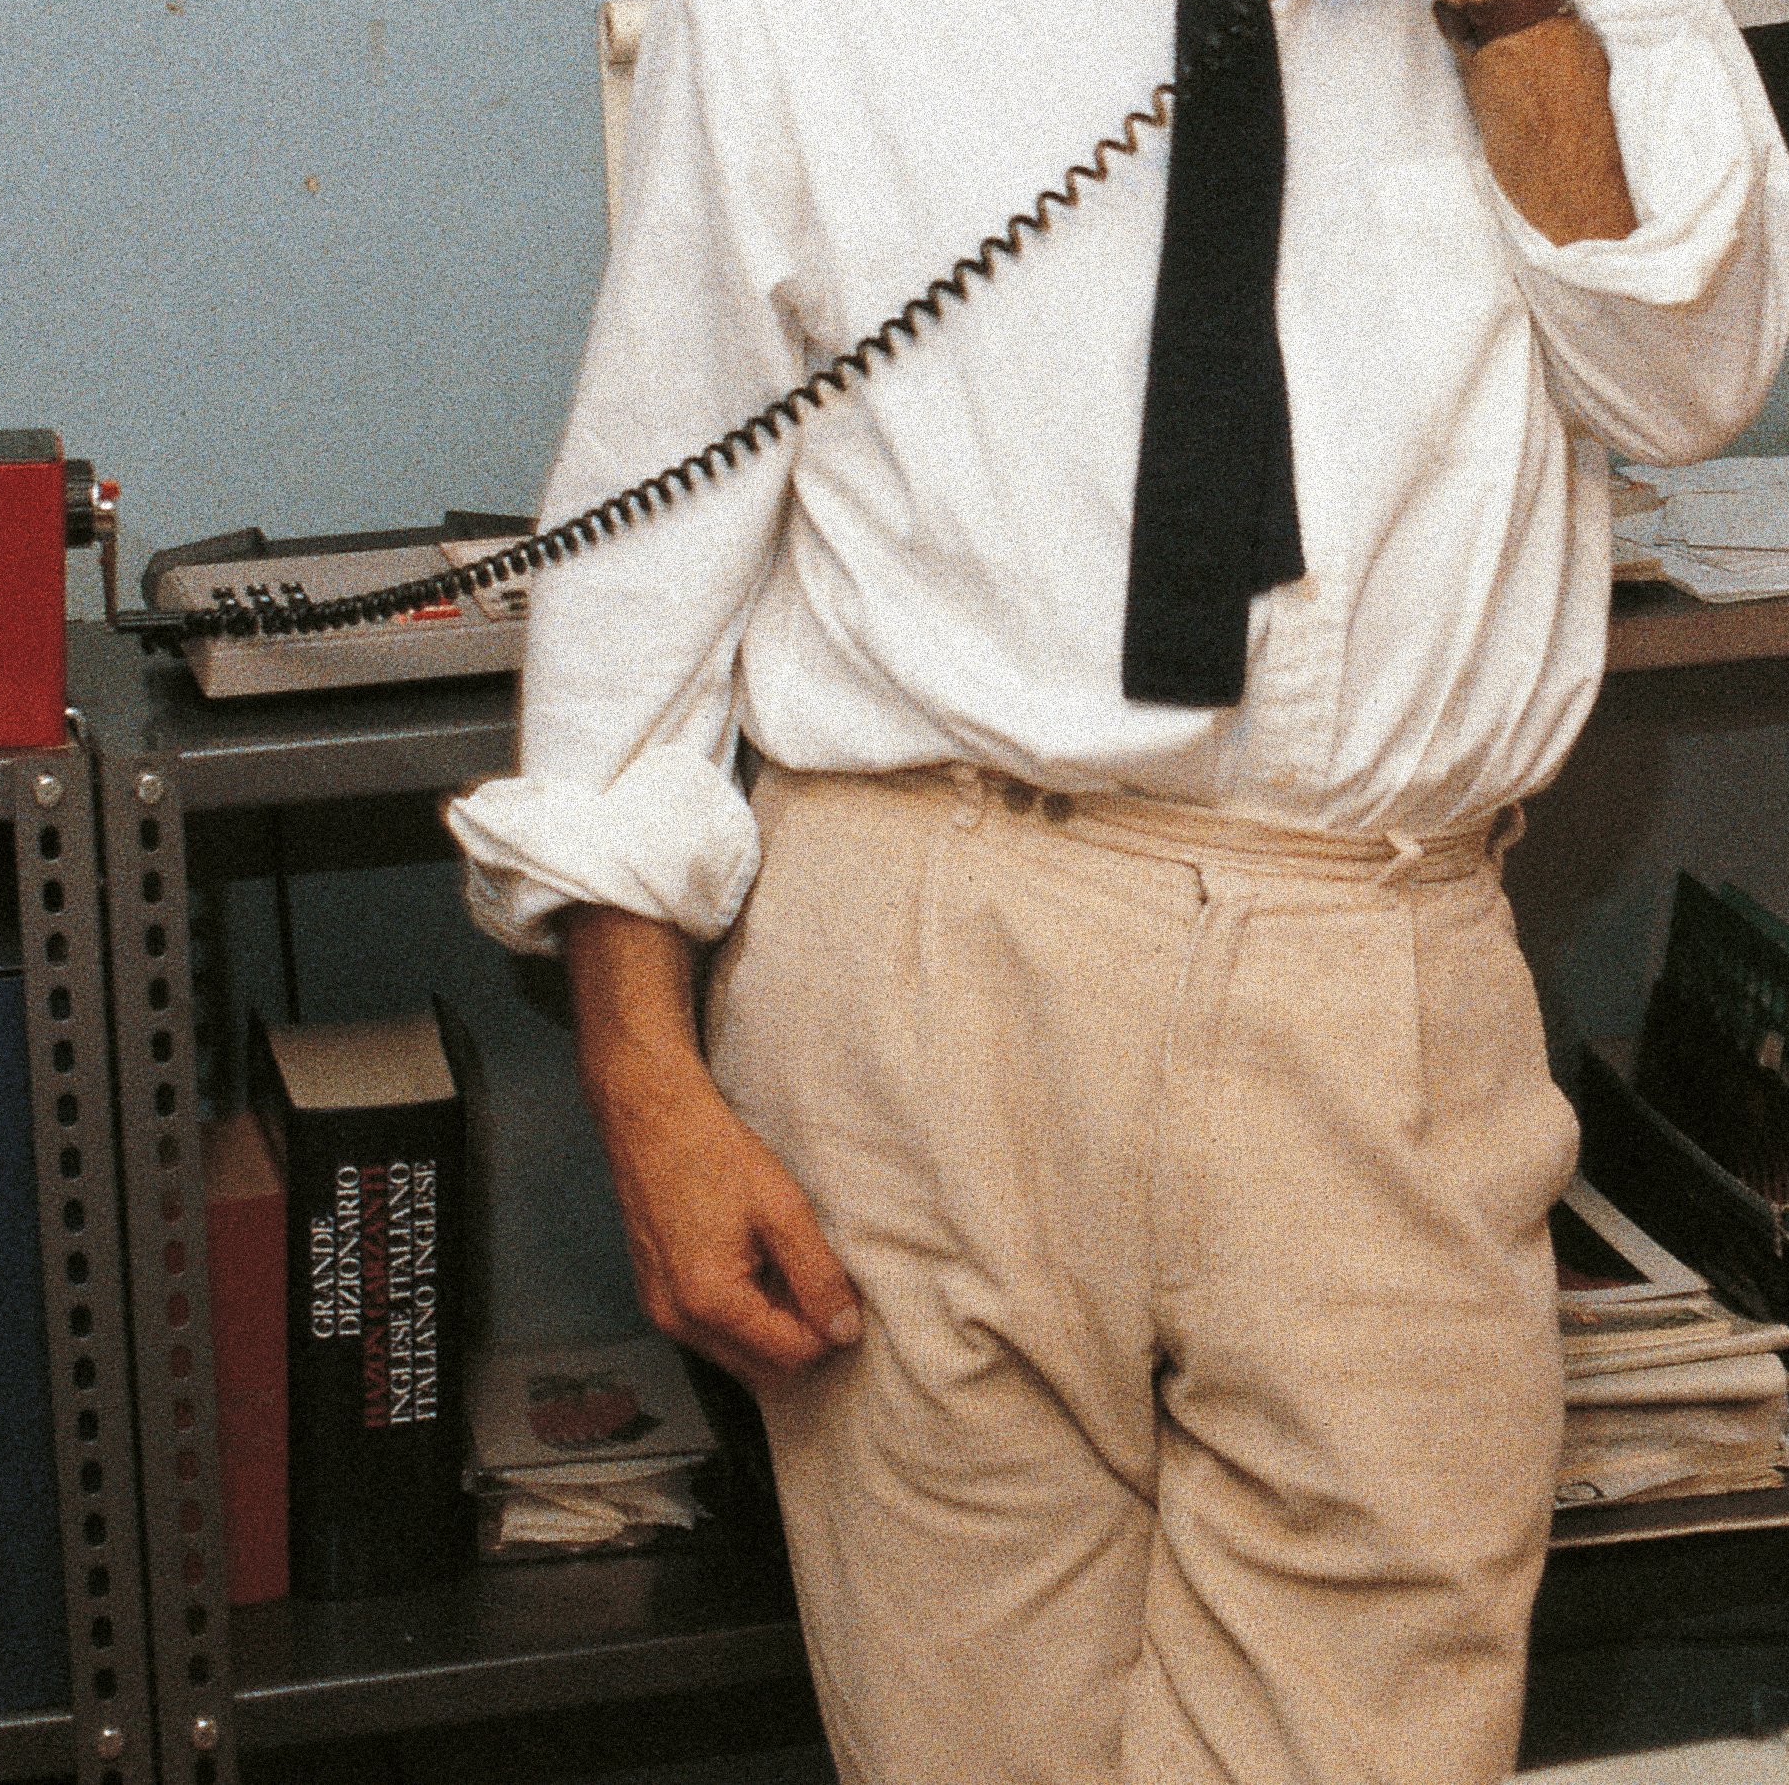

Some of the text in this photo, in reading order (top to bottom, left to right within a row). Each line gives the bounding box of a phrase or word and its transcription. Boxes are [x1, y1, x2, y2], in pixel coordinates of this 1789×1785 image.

[310, 1216, 336, 1339] GRANDE
[335, 1165, 362, 1337] DIZIONARIO
[361, 1165, 386, 1318] GARZANTI
[388, 1162, 413, 1424] INGLESE ITALIANO
[412, 1159, 438, 1421] ITALIANO INGLESE
